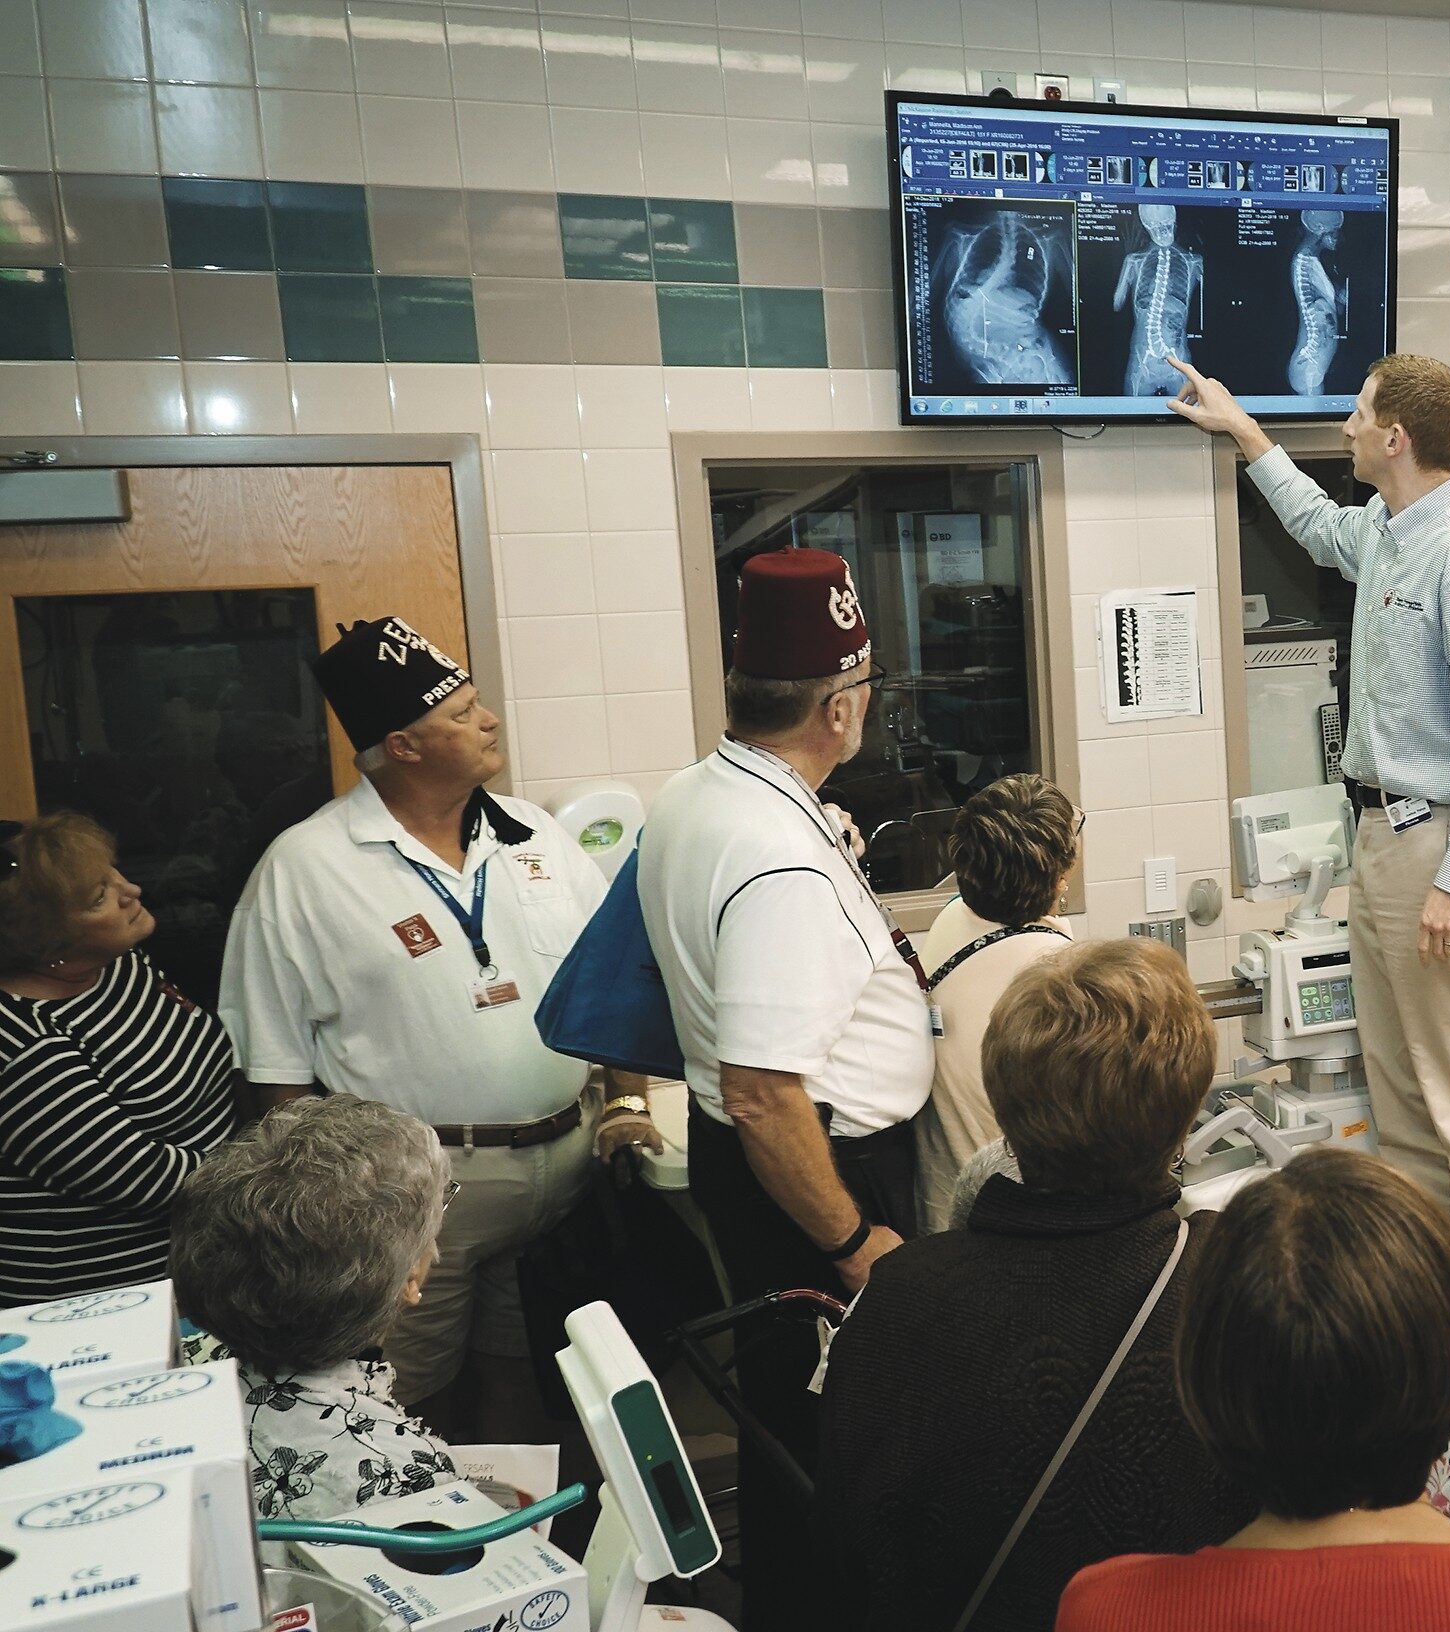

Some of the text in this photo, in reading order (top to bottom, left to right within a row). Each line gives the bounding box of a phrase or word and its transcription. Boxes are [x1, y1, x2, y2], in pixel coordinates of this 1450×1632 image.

[940, 533, 951, 541] BD
[840, 654, 857, 670] 20
[99, 1445, 195, 1470] MEDIUM
[31, 1573, 142, 1609] X-LARGE
[529, 1592, 563, 1610] SAFETY
[530, 1611, 561, 1628] CHOICE
